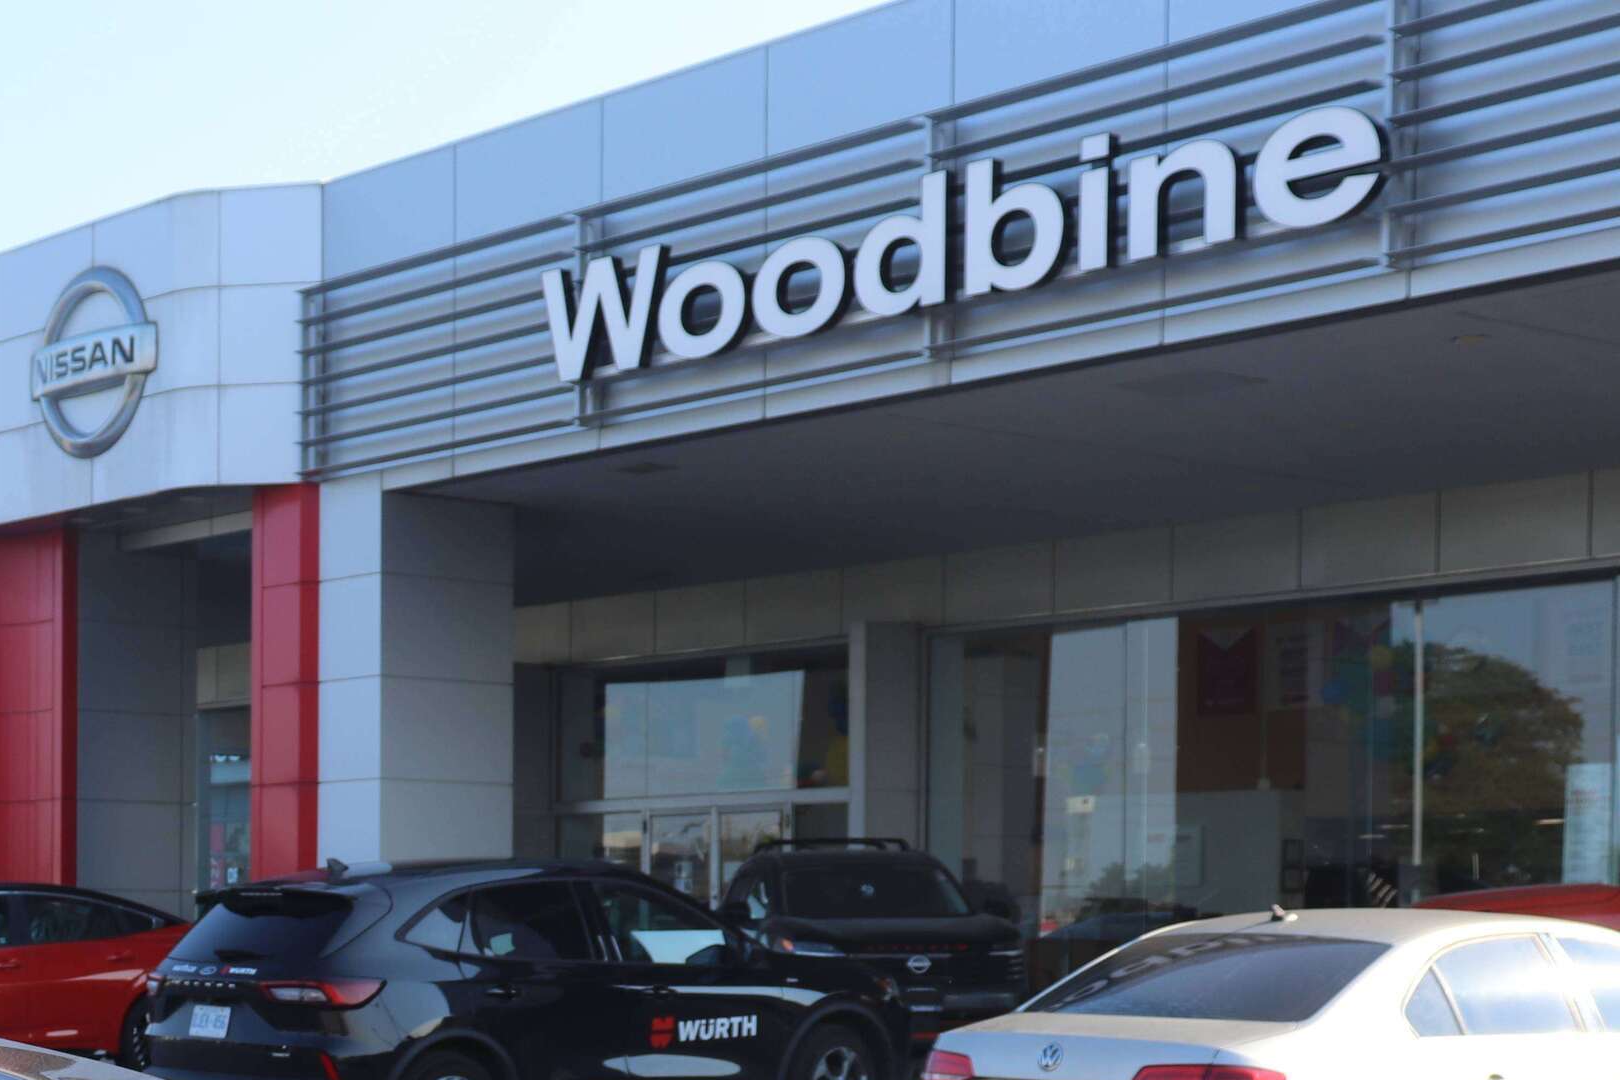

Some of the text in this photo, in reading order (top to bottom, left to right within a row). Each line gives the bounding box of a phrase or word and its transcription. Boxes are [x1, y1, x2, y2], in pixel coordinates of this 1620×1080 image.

[541, 105, 1383, 382] Woodbine
[36, 334, 136, 385] NISSAN
[677, 1014, 759, 1043] WÜRTH
